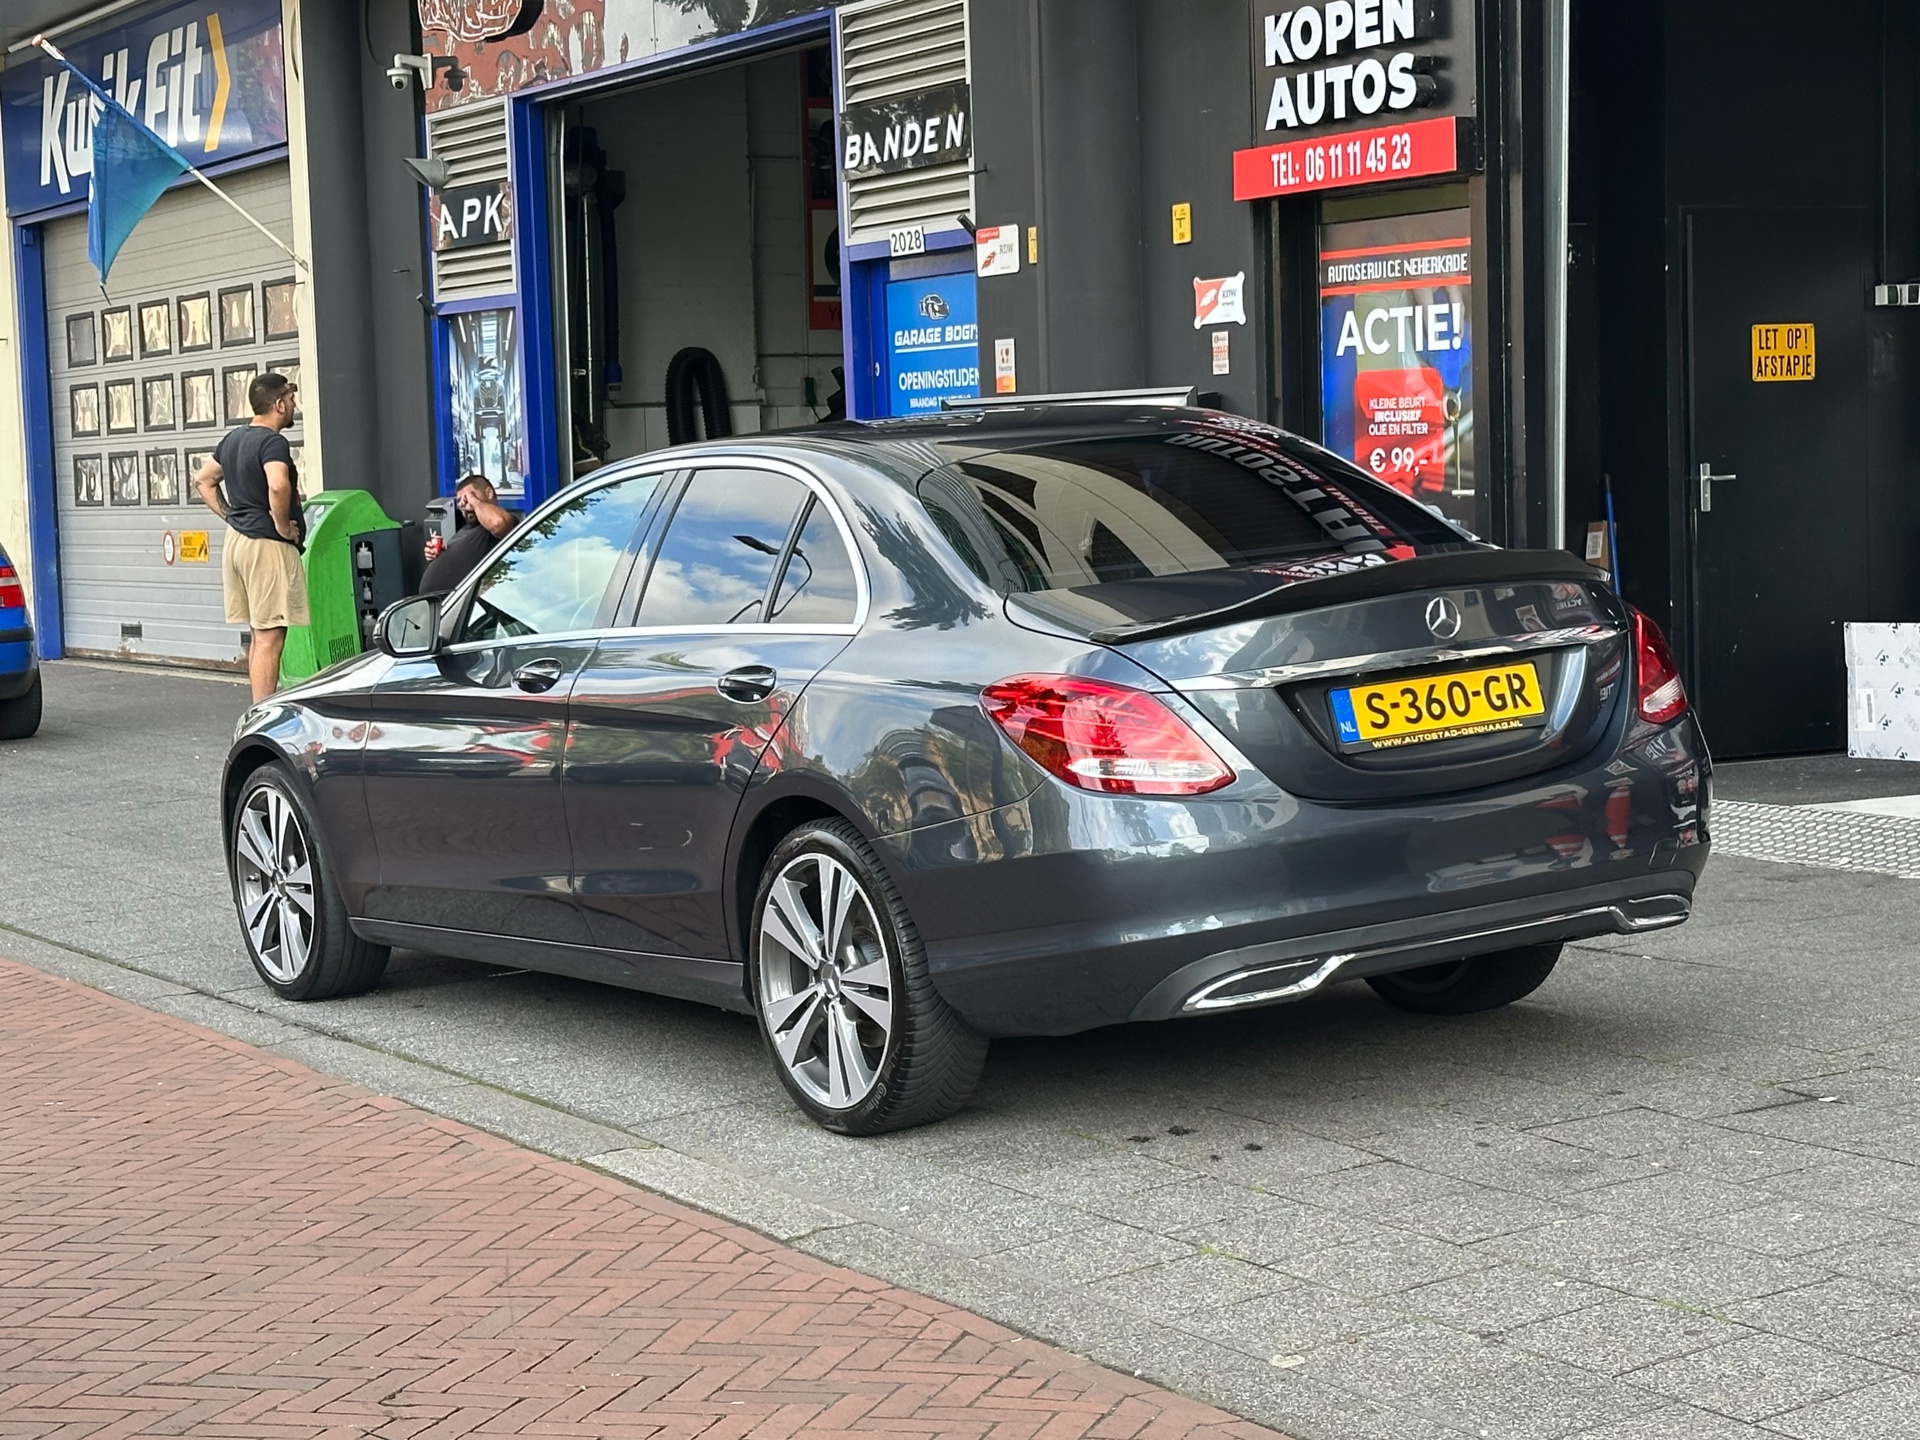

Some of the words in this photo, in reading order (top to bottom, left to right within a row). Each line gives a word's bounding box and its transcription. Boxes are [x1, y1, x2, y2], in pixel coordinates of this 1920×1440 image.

[1264, 0, 1415, 67] KOPEN
[1264, 52, 1417, 131] AUTOS
[41, 49, 141, 194] Kwk
[844, 111, 965, 170] BANDEN
[1270, 151, 1300, 188] TEL:
[1305, 146, 1325, 183] 06
[1328, 143, 1343, 179] 11
[1347, 140, 1361, 177] 11
[1366, 136, 1387, 173] 45
[1391, 132, 1411, 170] 23
[439, 191, 505, 242] APK
[890, 229, 922, 254] 2028
[1327, 260, 1402, 284] AUTOSERVICE
[1404, 253, 1468, 277] NEHERKADE
[895, 326, 942, 347] GARAGE
[1336, 302, 1462, 357] ACTIE!
[1758, 328, 1779, 350] LET
[1787, 328, 1808, 350] OP!
[1756, 354, 1812, 378] AFSTAPJE
[1368, 397, 1398, 410] KLEINE
[1398, 396, 1426, 409] BEURT
[1374, 410, 1422, 423] INCLUSIEF
[1388, 422, 1400, 435] EN
[1401, 422, 1429, 435] FILTER
[1369, 447, 1387, 473] €
[1390, 446, 1429, 477] 99,-
[1365, 673, 1532, 730] S-360-GR
[1340, 721, 1356, 734] NL
